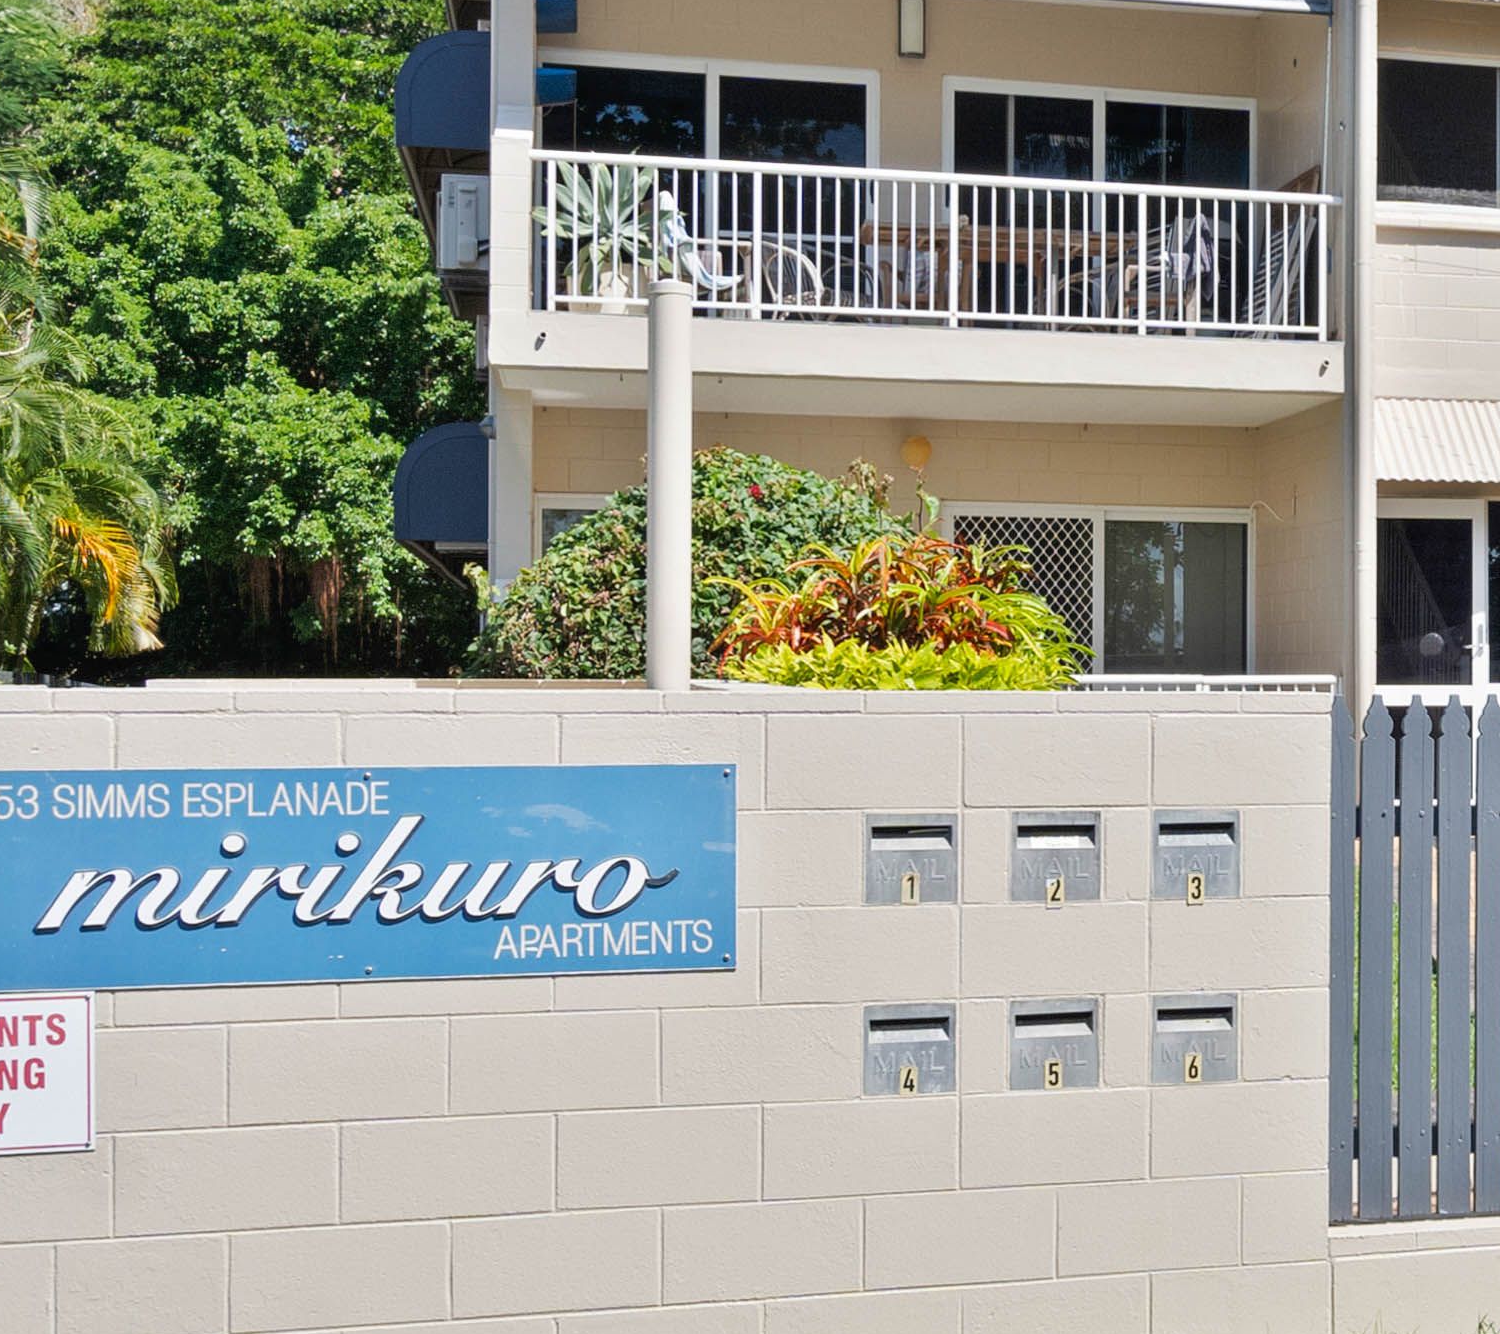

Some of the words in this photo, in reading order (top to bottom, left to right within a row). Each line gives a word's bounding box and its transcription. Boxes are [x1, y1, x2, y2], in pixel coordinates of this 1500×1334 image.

[51, 782, 171, 820] SIMMS
[182, 780, 390, 818] ESPLANADE
[33, 813, 680, 935] mirikuro
[875, 858, 948, 884] MAIL
[1021, 856, 1092, 881] MAIL
[1162, 853, 1229, 877] MAIL
[906, 874, 915, 900] 1
[1050, 878, 1061, 902] 2
[1191, 876, 1202, 900] 3
[493, 918, 713, 961] APARTMENTS
[874, 1050, 947, 1075] MAIL
[1019, 1043, 1088, 1069] MAIL
[1160, 1037, 1228, 1063] MAIL
[1048, 1062, 1059, 1086] 5
[1188, 1055, 1199, 1079] 6
[903, 1068, 915, 1092] 4
